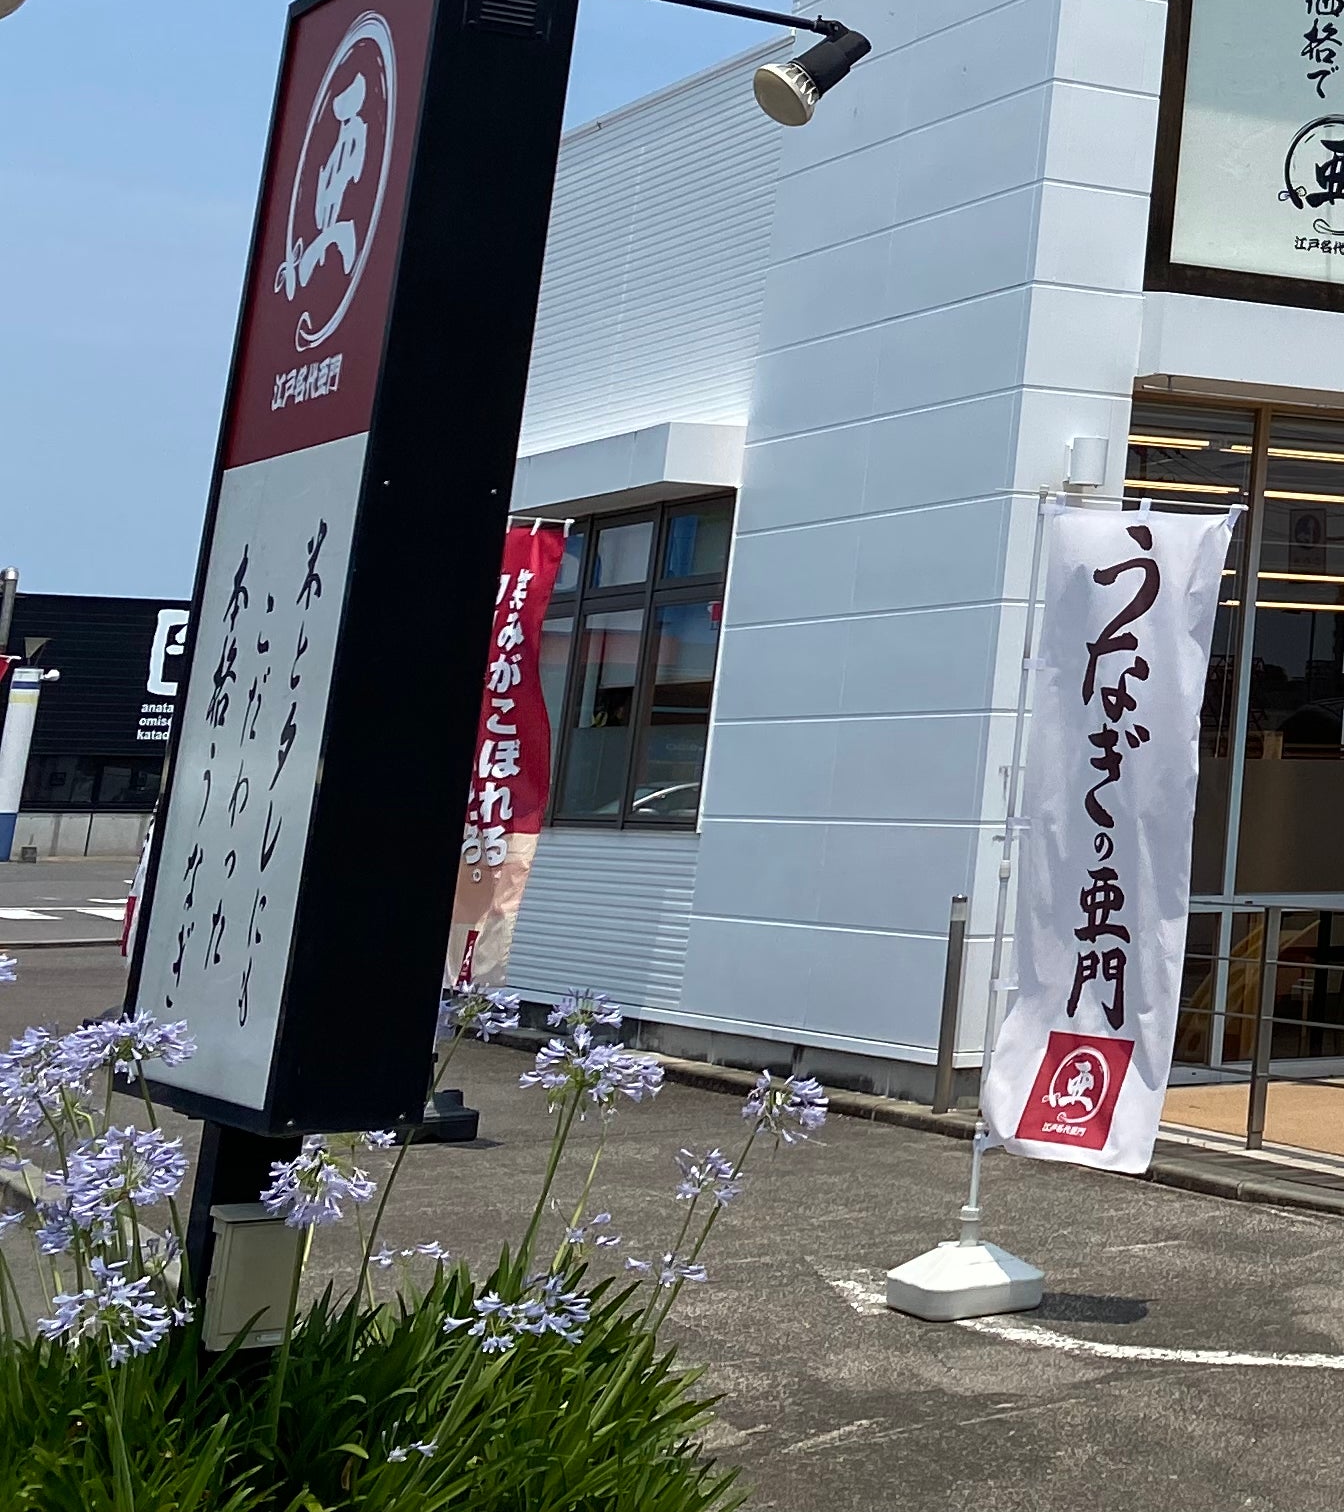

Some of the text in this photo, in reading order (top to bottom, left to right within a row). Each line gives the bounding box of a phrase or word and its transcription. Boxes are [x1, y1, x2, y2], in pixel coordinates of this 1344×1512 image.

[166, 544, 249, 1008] 本格うなぎ
[204, 592, 273, 971] こだわった
[239, 519, 327, 1027] 米とタレにも
[1065, 524, 1162, 1033] うなぎの亜門
